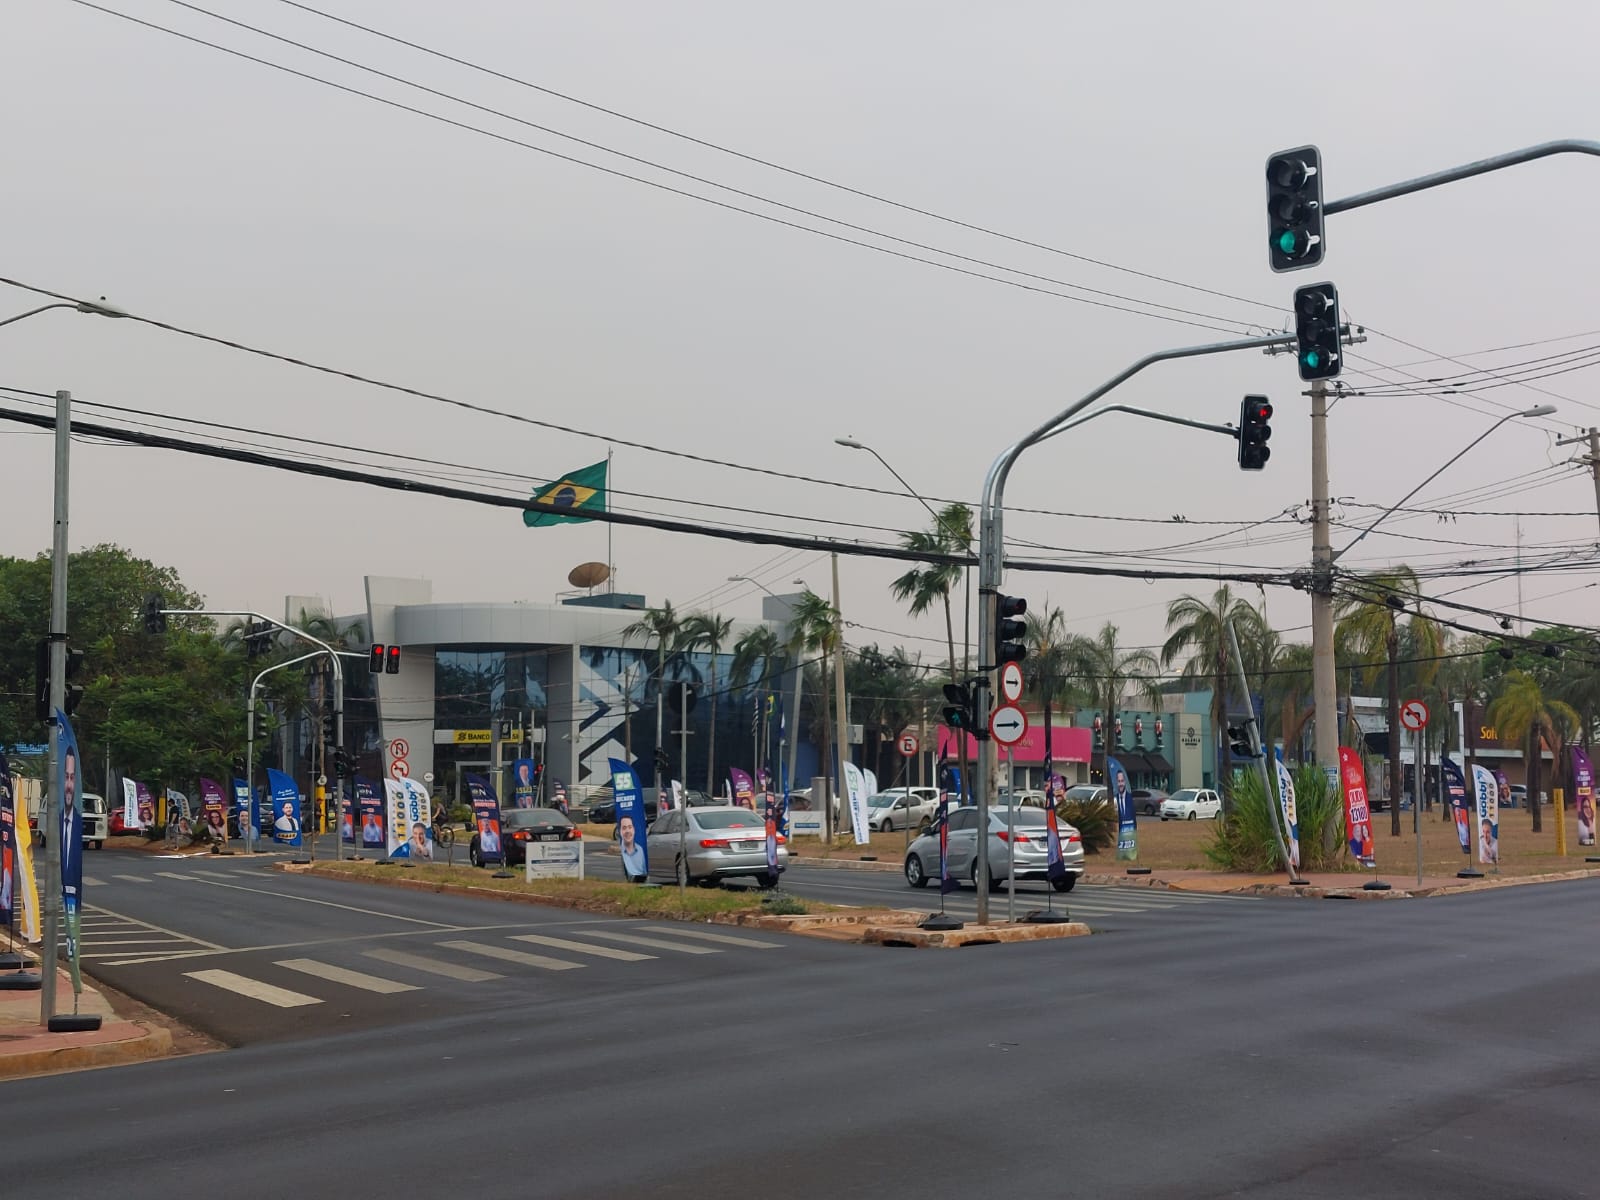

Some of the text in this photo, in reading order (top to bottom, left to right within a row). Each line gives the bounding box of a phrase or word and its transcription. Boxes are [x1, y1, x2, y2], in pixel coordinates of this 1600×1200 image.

[616, 773, 632, 787] 55
[394, 791, 405, 838] 11000
[409, 790, 419, 822] Gobbi
